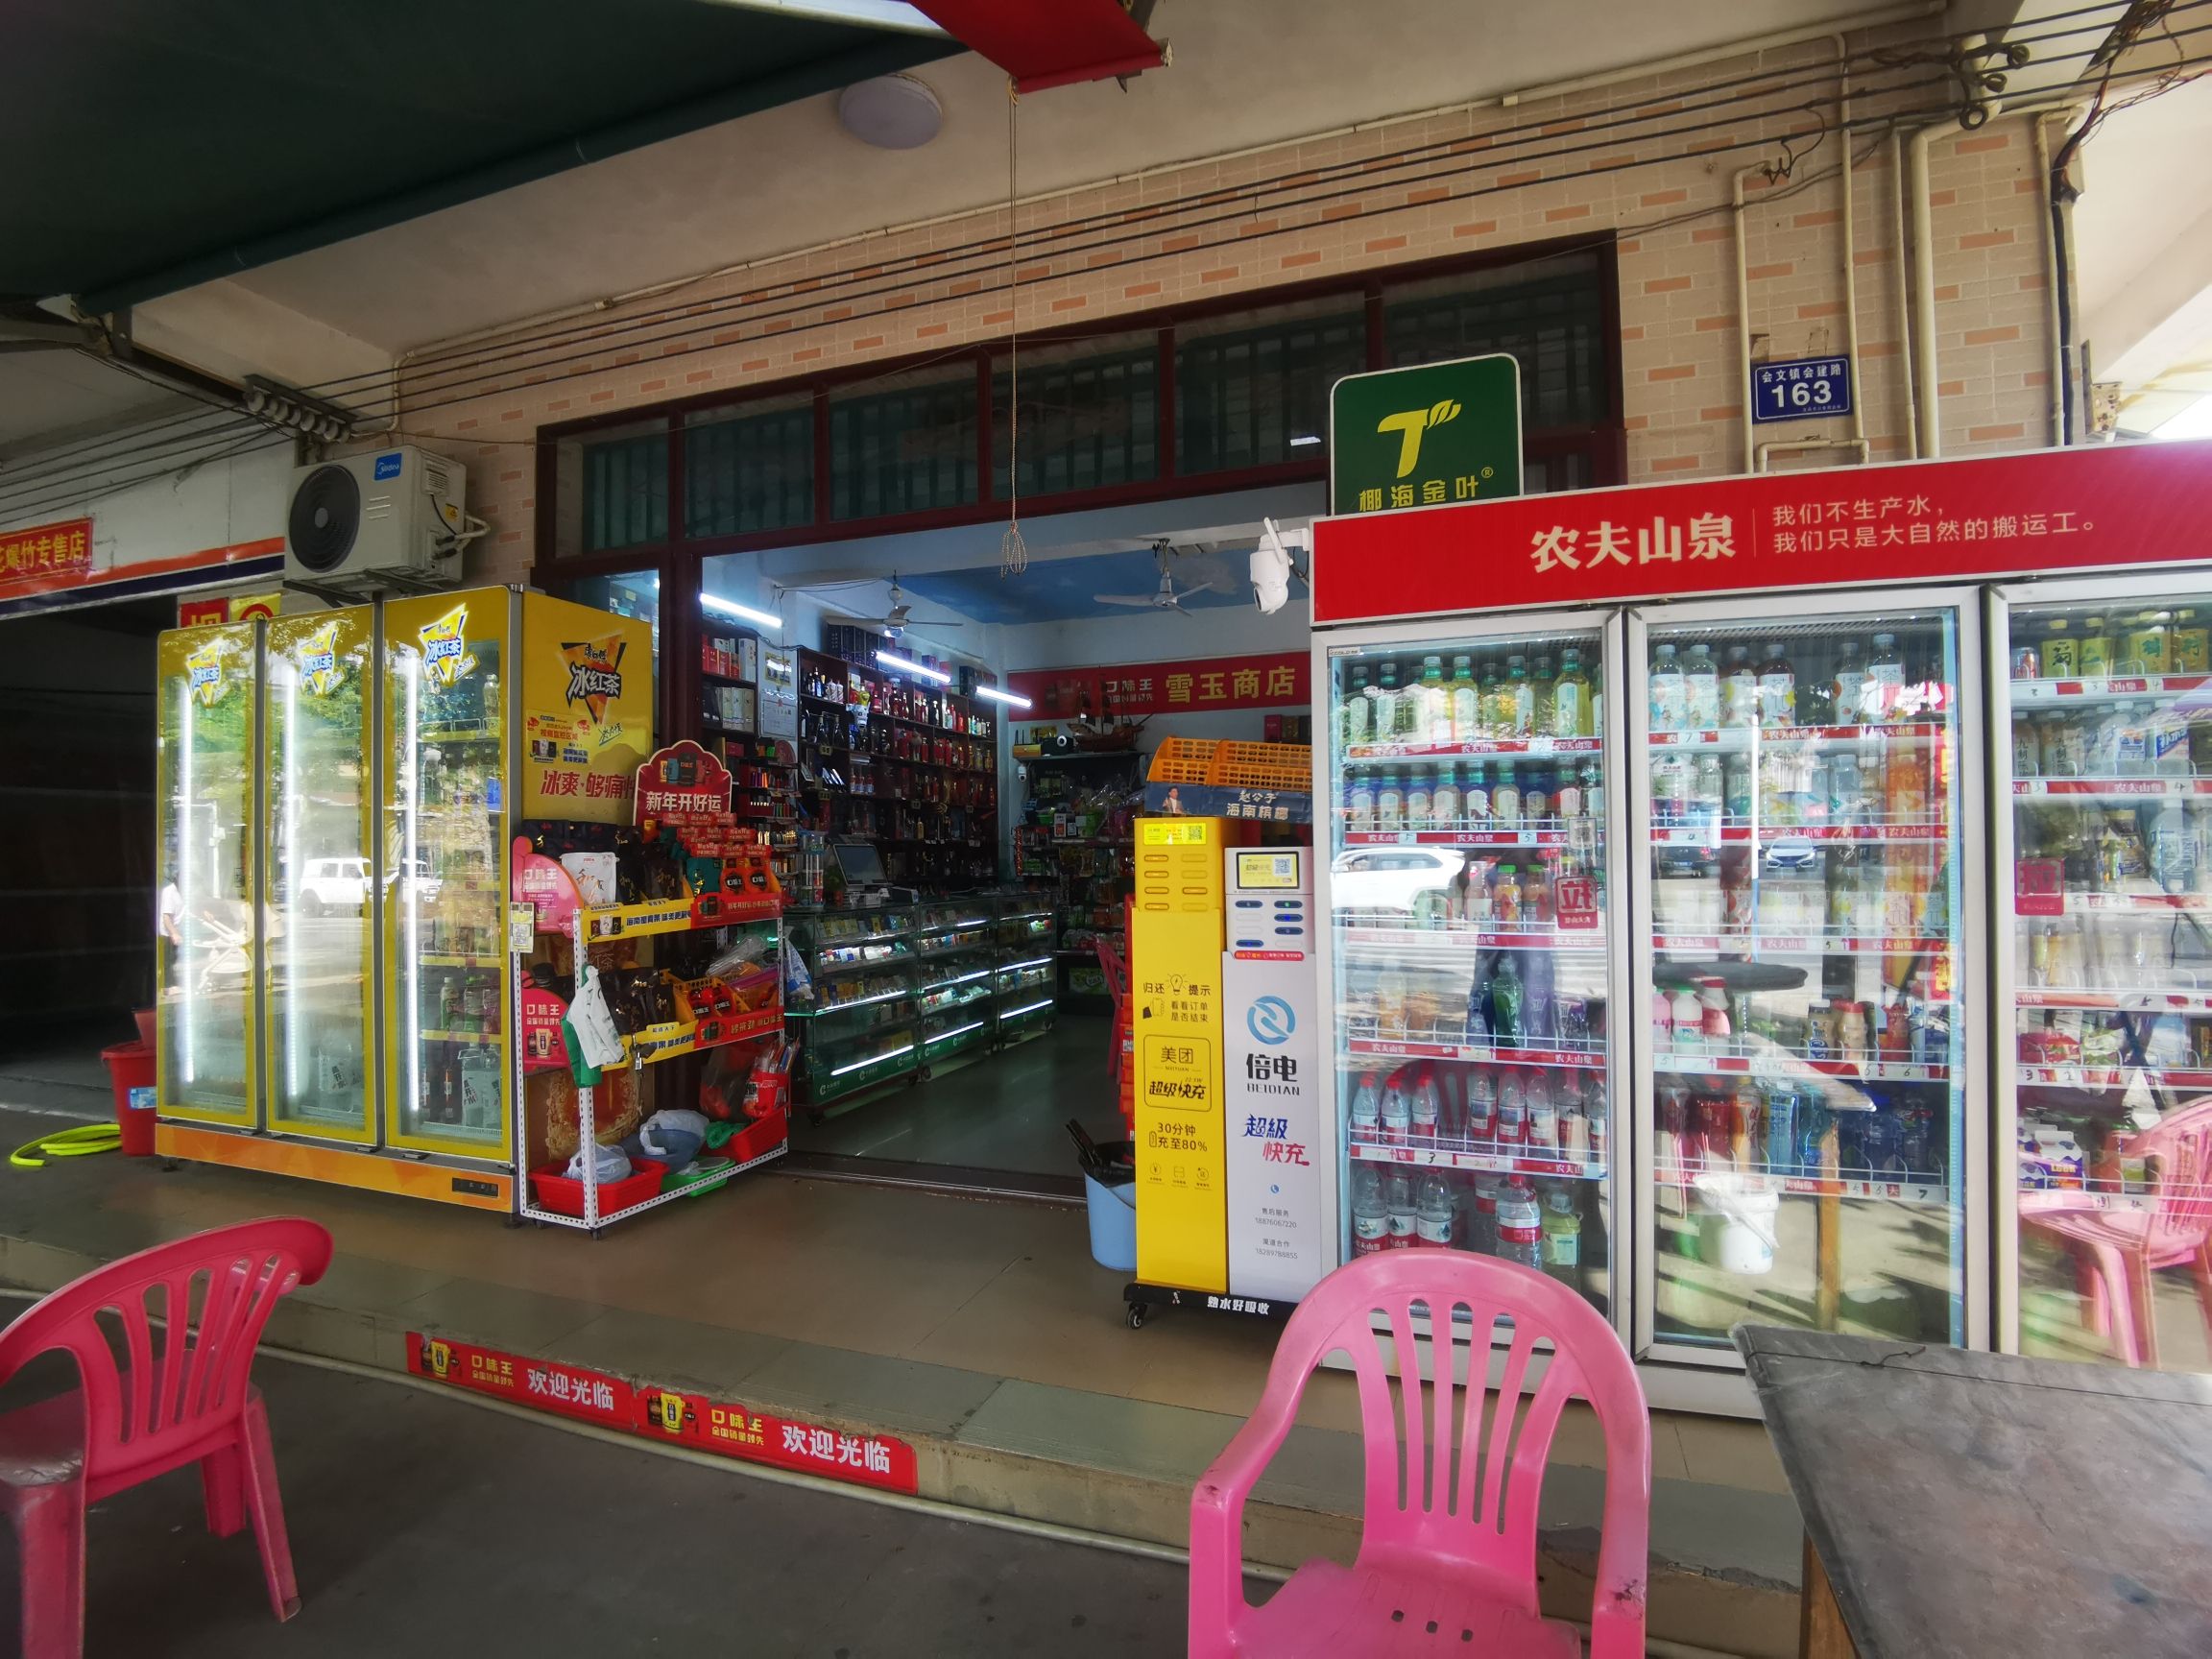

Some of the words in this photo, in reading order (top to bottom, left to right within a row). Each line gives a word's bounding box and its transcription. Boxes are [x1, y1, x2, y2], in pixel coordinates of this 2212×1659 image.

[1762, 364, 1841, 383] 会文镇会建路
[1771, 380, 1832, 408] 163
[377, 457, 400, 475] Midea
[1358, 475, 1479, 512] 椰海金叶
[1772, 511, 2097, 554] 我们只是大自然的搬运工。
[1529, 512, 1737, 573] 农夫山泉
[566, 662, 622, 703] 冰红茶
[1166, 666, 1296, 704] 雪玉商店
[645, 791, 722, 813] 新年开好运
[1225, 802, 1289, 820] 海南槟榔
[1456, 832, 1494, 843] 农夫山泉
[1143, 983, 1165, 995] 归还
[1189, 984, 1211, 996] 提示
[526, 1003, 560, 1016] 口味王
[1161, 1046, 1193, 1064] 美团
[1554, 1054, 1594, 1065] 农夫山泉
[1246, 1053, 1298, 1082] 倍电
[1149, 1080, 1207, 1099] 超级快充
[1247, 1083, 1300, 1095] BEIDIAN
[1157, 1123, 1196, 1137] 30分钟
[1158, 1137, 1208, 1152] 充至80%
[1262, 1142, 1310, 1166] 快充
[1428, 1151, 1436, 1164] 3
[1554, 1164, 1584, 1175] 农夫山
[1262, 1208, 1289, 1217] 售后服务
[471, 1355, 514, 1376] 口味王
[471, 1369, 515, 1387] 全国销量领先
[527, 1367, 614, 1411] 欢迎光临
[711, 1408, 763, 1433] 口味王
[711, 1426, 765, 1446] 全国销量领先
[781, 1425, 891, 1474] 欢迎光临
